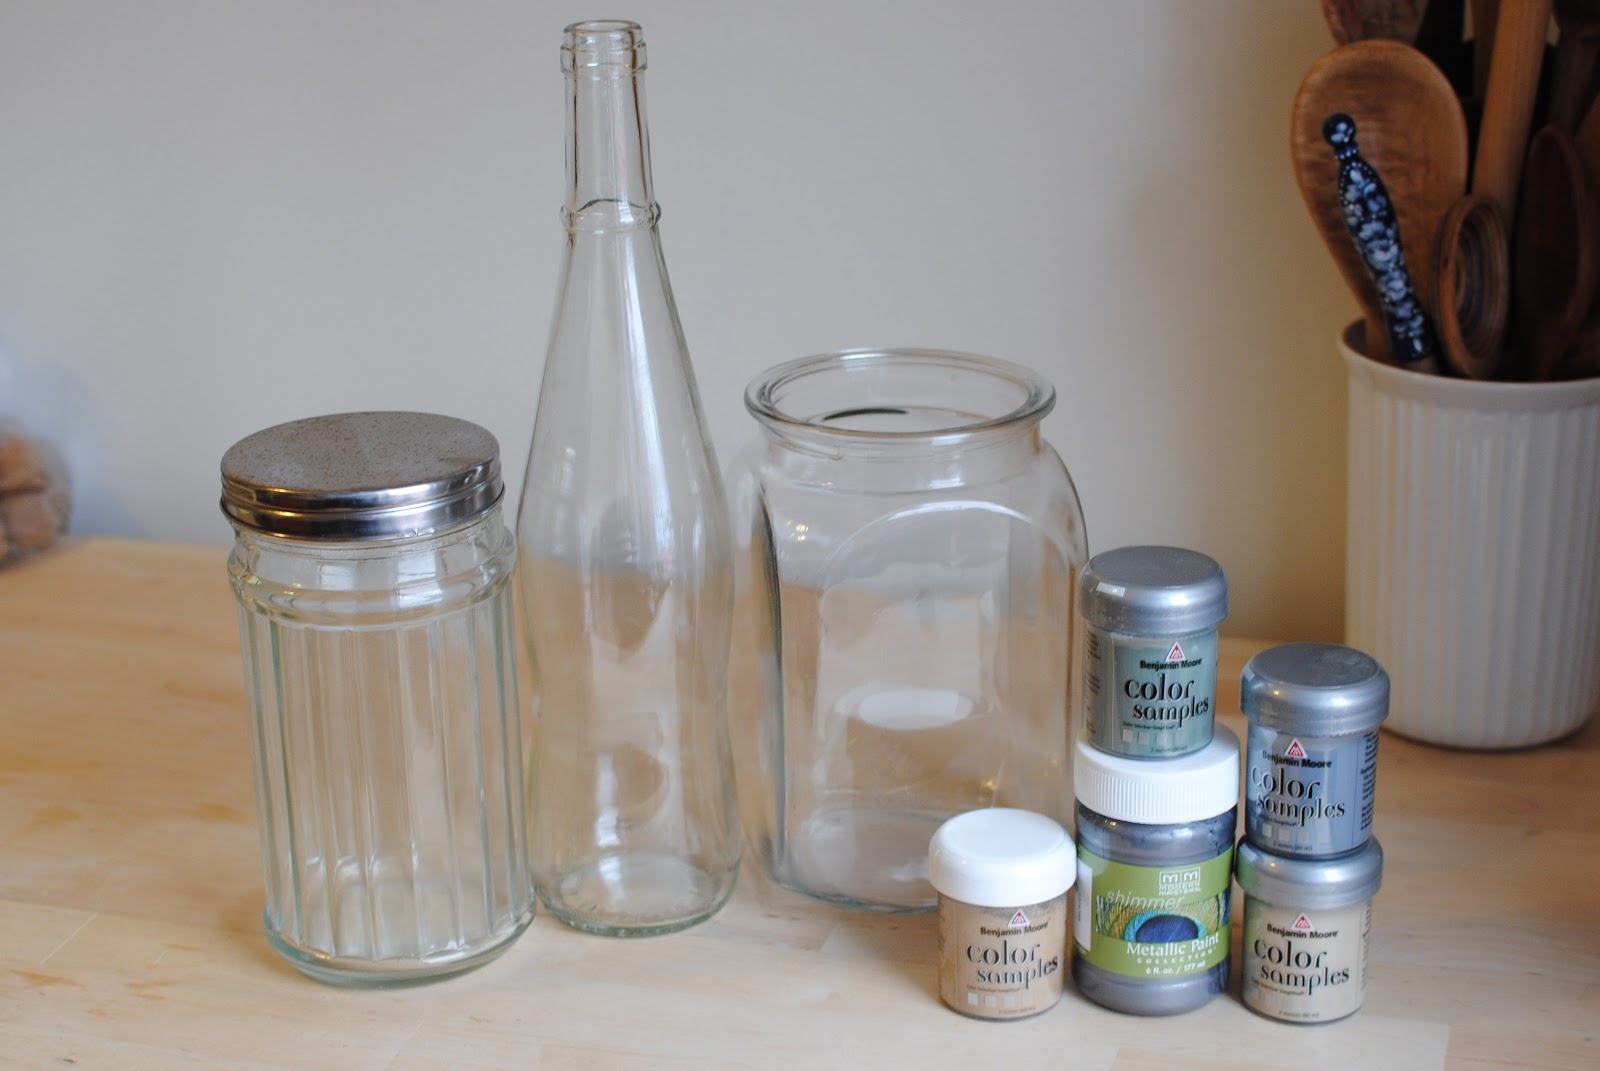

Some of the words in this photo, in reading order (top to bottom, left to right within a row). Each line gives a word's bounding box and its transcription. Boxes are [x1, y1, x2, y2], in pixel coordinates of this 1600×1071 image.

[1140, 660, 1179, 672] Benjamin
[1132, 697, 1209, 727] samples
[1262, 750, 1299, 766] Benjamin
[1301, 759, 1332, 768] Moore
[1257, 792, 1345, 827] samples
[1105, 889, 1184, 910] shimmer
[980, 926, 1022, 938] Benjamin
[1024, 922, 1048, 934] Moore
[1267, 923, 1306, 938] Benjamin
[1310, 930, 1338, 939] Moore
[1126, 942, 1186, 957] Metallic
[1192, 932, 1218, 952] Paint
[1137, 947, 1213, 964] COLLECTION
[977, 956, 1058, 990] samples
[1260, 965, 1350, 996] samples
